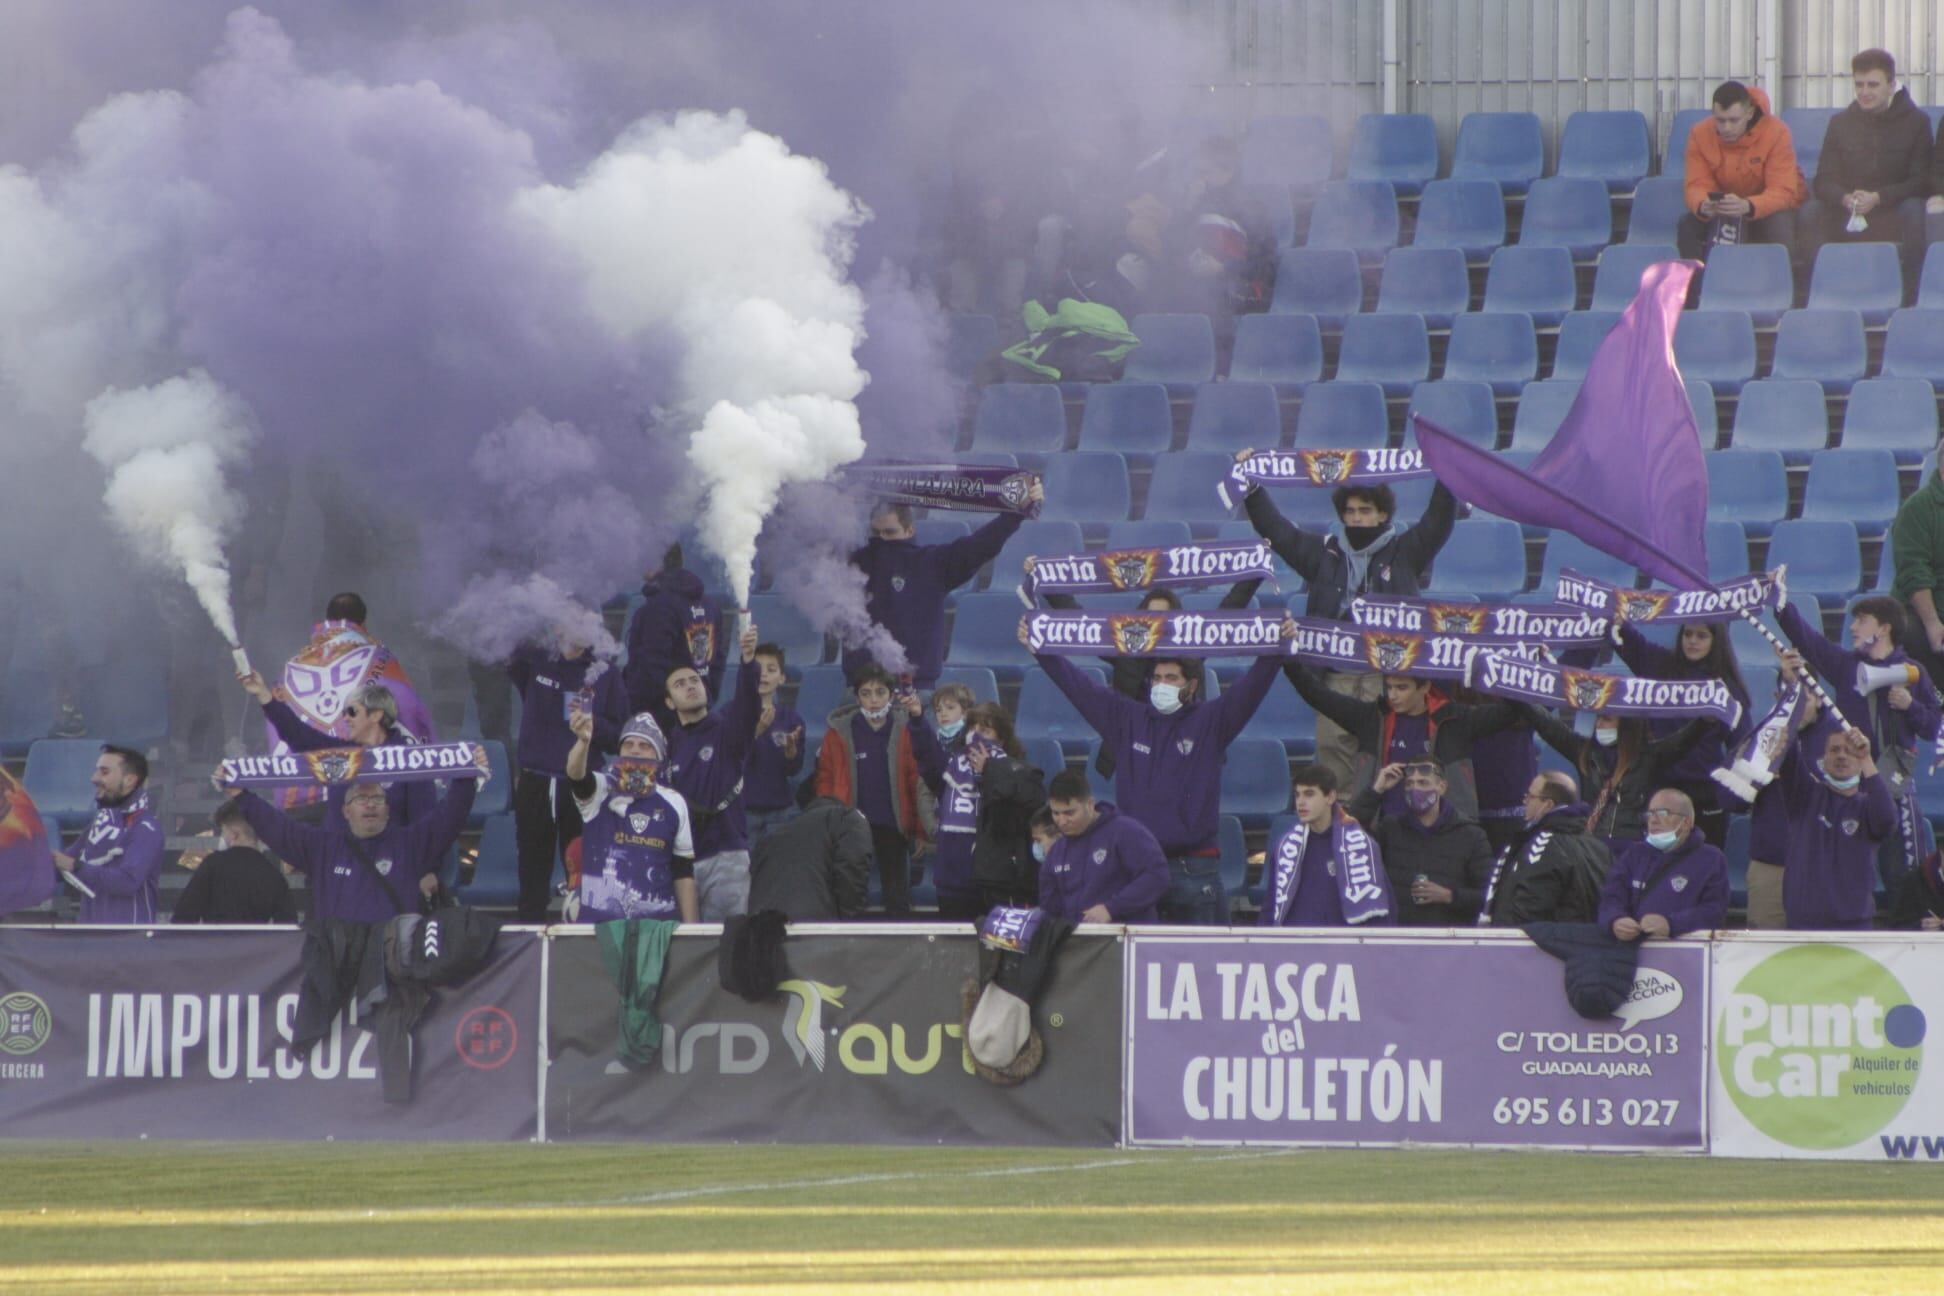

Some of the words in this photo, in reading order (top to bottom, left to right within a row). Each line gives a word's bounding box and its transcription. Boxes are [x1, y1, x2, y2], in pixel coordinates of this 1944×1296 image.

[1030, 614, 1102, 650] Furia
[1171, 615, 1280, 645] Morada
[1351, 597, 1422, 630] Furia
[1494, 608, 1608, 638] Morada
[1483, 654, 1556, 694] Furia
[1622, 677, 1730, 707] Morada
[1147, 962, 1202, 1020] LA
[1215, 962, 1361, 1022] TASCA
[1261, 1019, 1306, 1056] del
[1497, 1032, 1523, 1054] C/
[0, 1063, 45, 1079] ERCERA
[1522, 1061, 1653, 1078] GUADALAJARA
[1733, 1041, 1850, 1098] Car
[1852, 1057, 1900, 1073] Alquiler
[1904, 1057, 1919, 1071] de
[1183, 1044, 1443, 1123] CHULETÓN
[1493, 1097, 1550, 1126] 695
[1558, 1097, 1613, 1126] 613
[1621, 1097, 1679, 1127] 027
